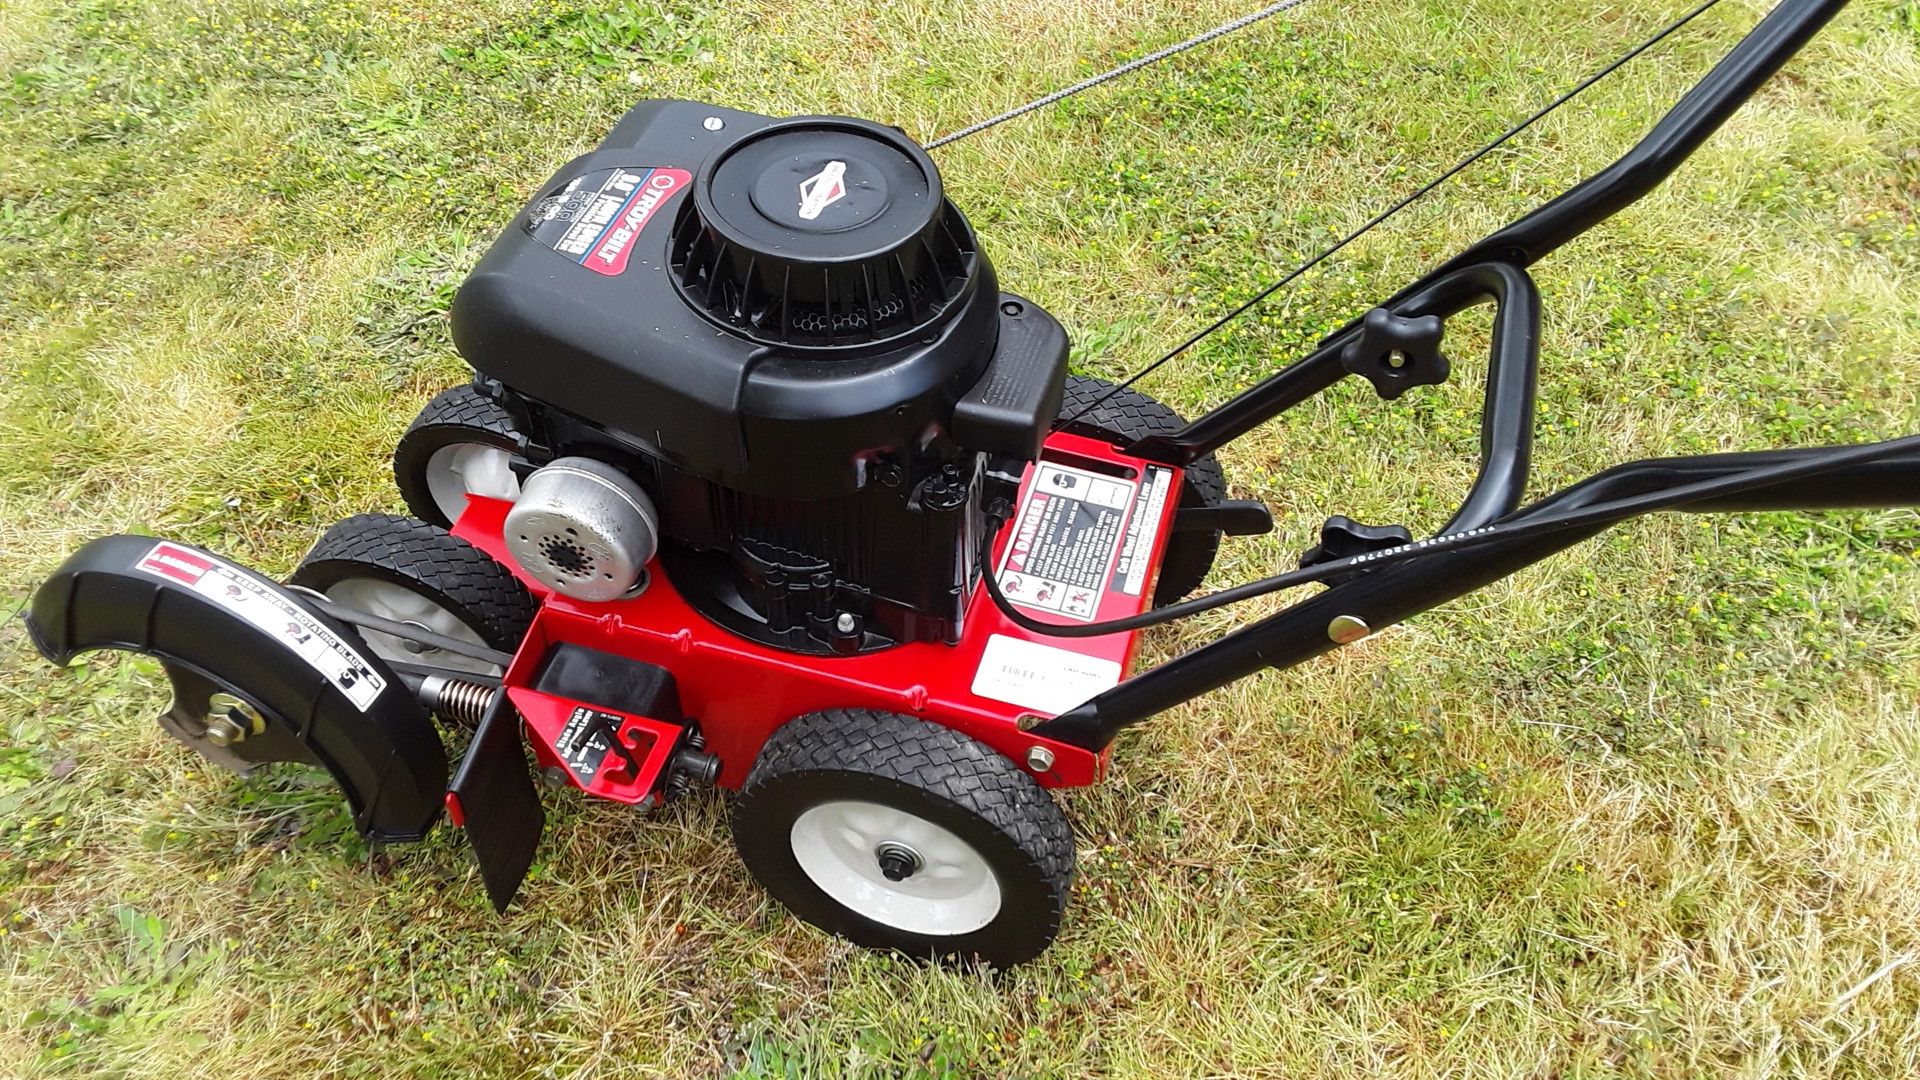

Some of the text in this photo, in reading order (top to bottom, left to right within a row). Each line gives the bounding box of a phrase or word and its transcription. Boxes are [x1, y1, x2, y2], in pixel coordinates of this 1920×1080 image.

[597, 187, 665, 264] TROY-BILT
[1018, 498, 1047, 552] DANGER
[1122, 535, 1136, 557] Wheel
[1138, 481, 1151, 499] Lever
[294, 613, 337, 648] ROTATING
[335, 645, 365, 672] BLADE
[556, 728, 573, 748] Blade
